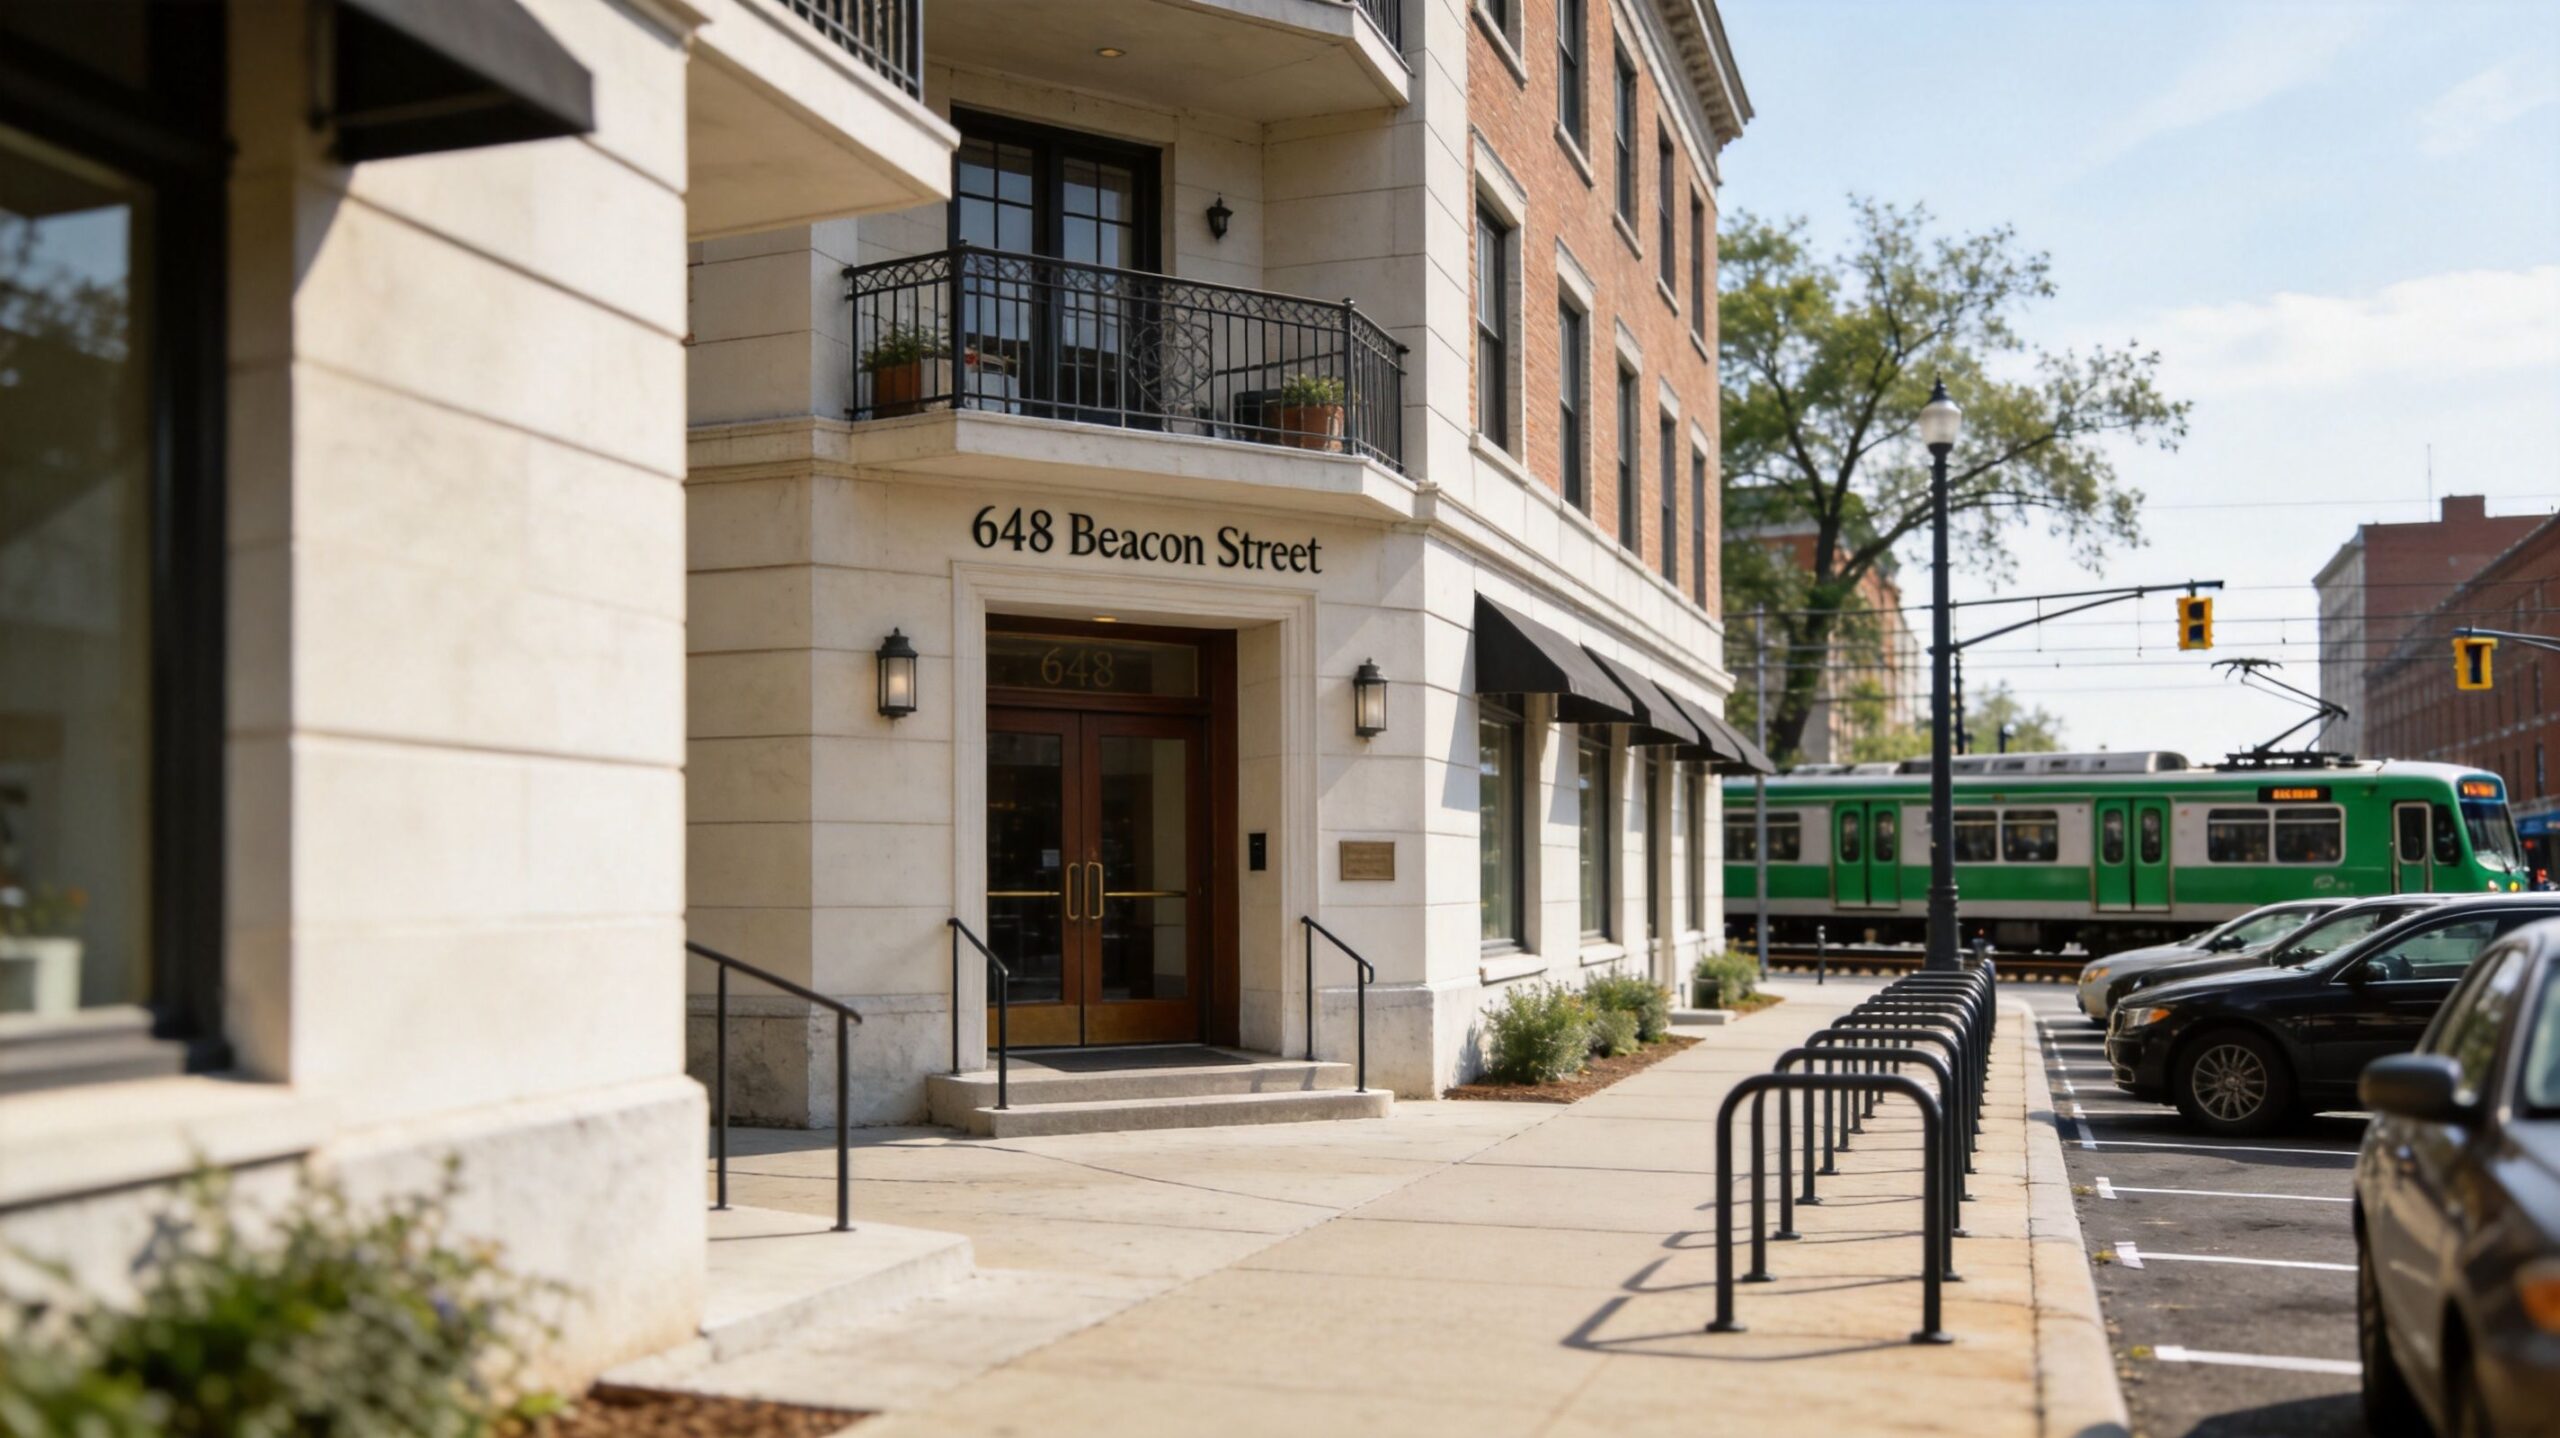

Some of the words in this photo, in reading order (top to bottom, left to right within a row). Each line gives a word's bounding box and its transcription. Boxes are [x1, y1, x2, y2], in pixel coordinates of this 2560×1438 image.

[971, 504, 1054, 554] 648
[1067, 512, 1206, 567] Beacon
[1216, 525, 1323, 575] Street
[1041, 646, 1115, 688] 648
